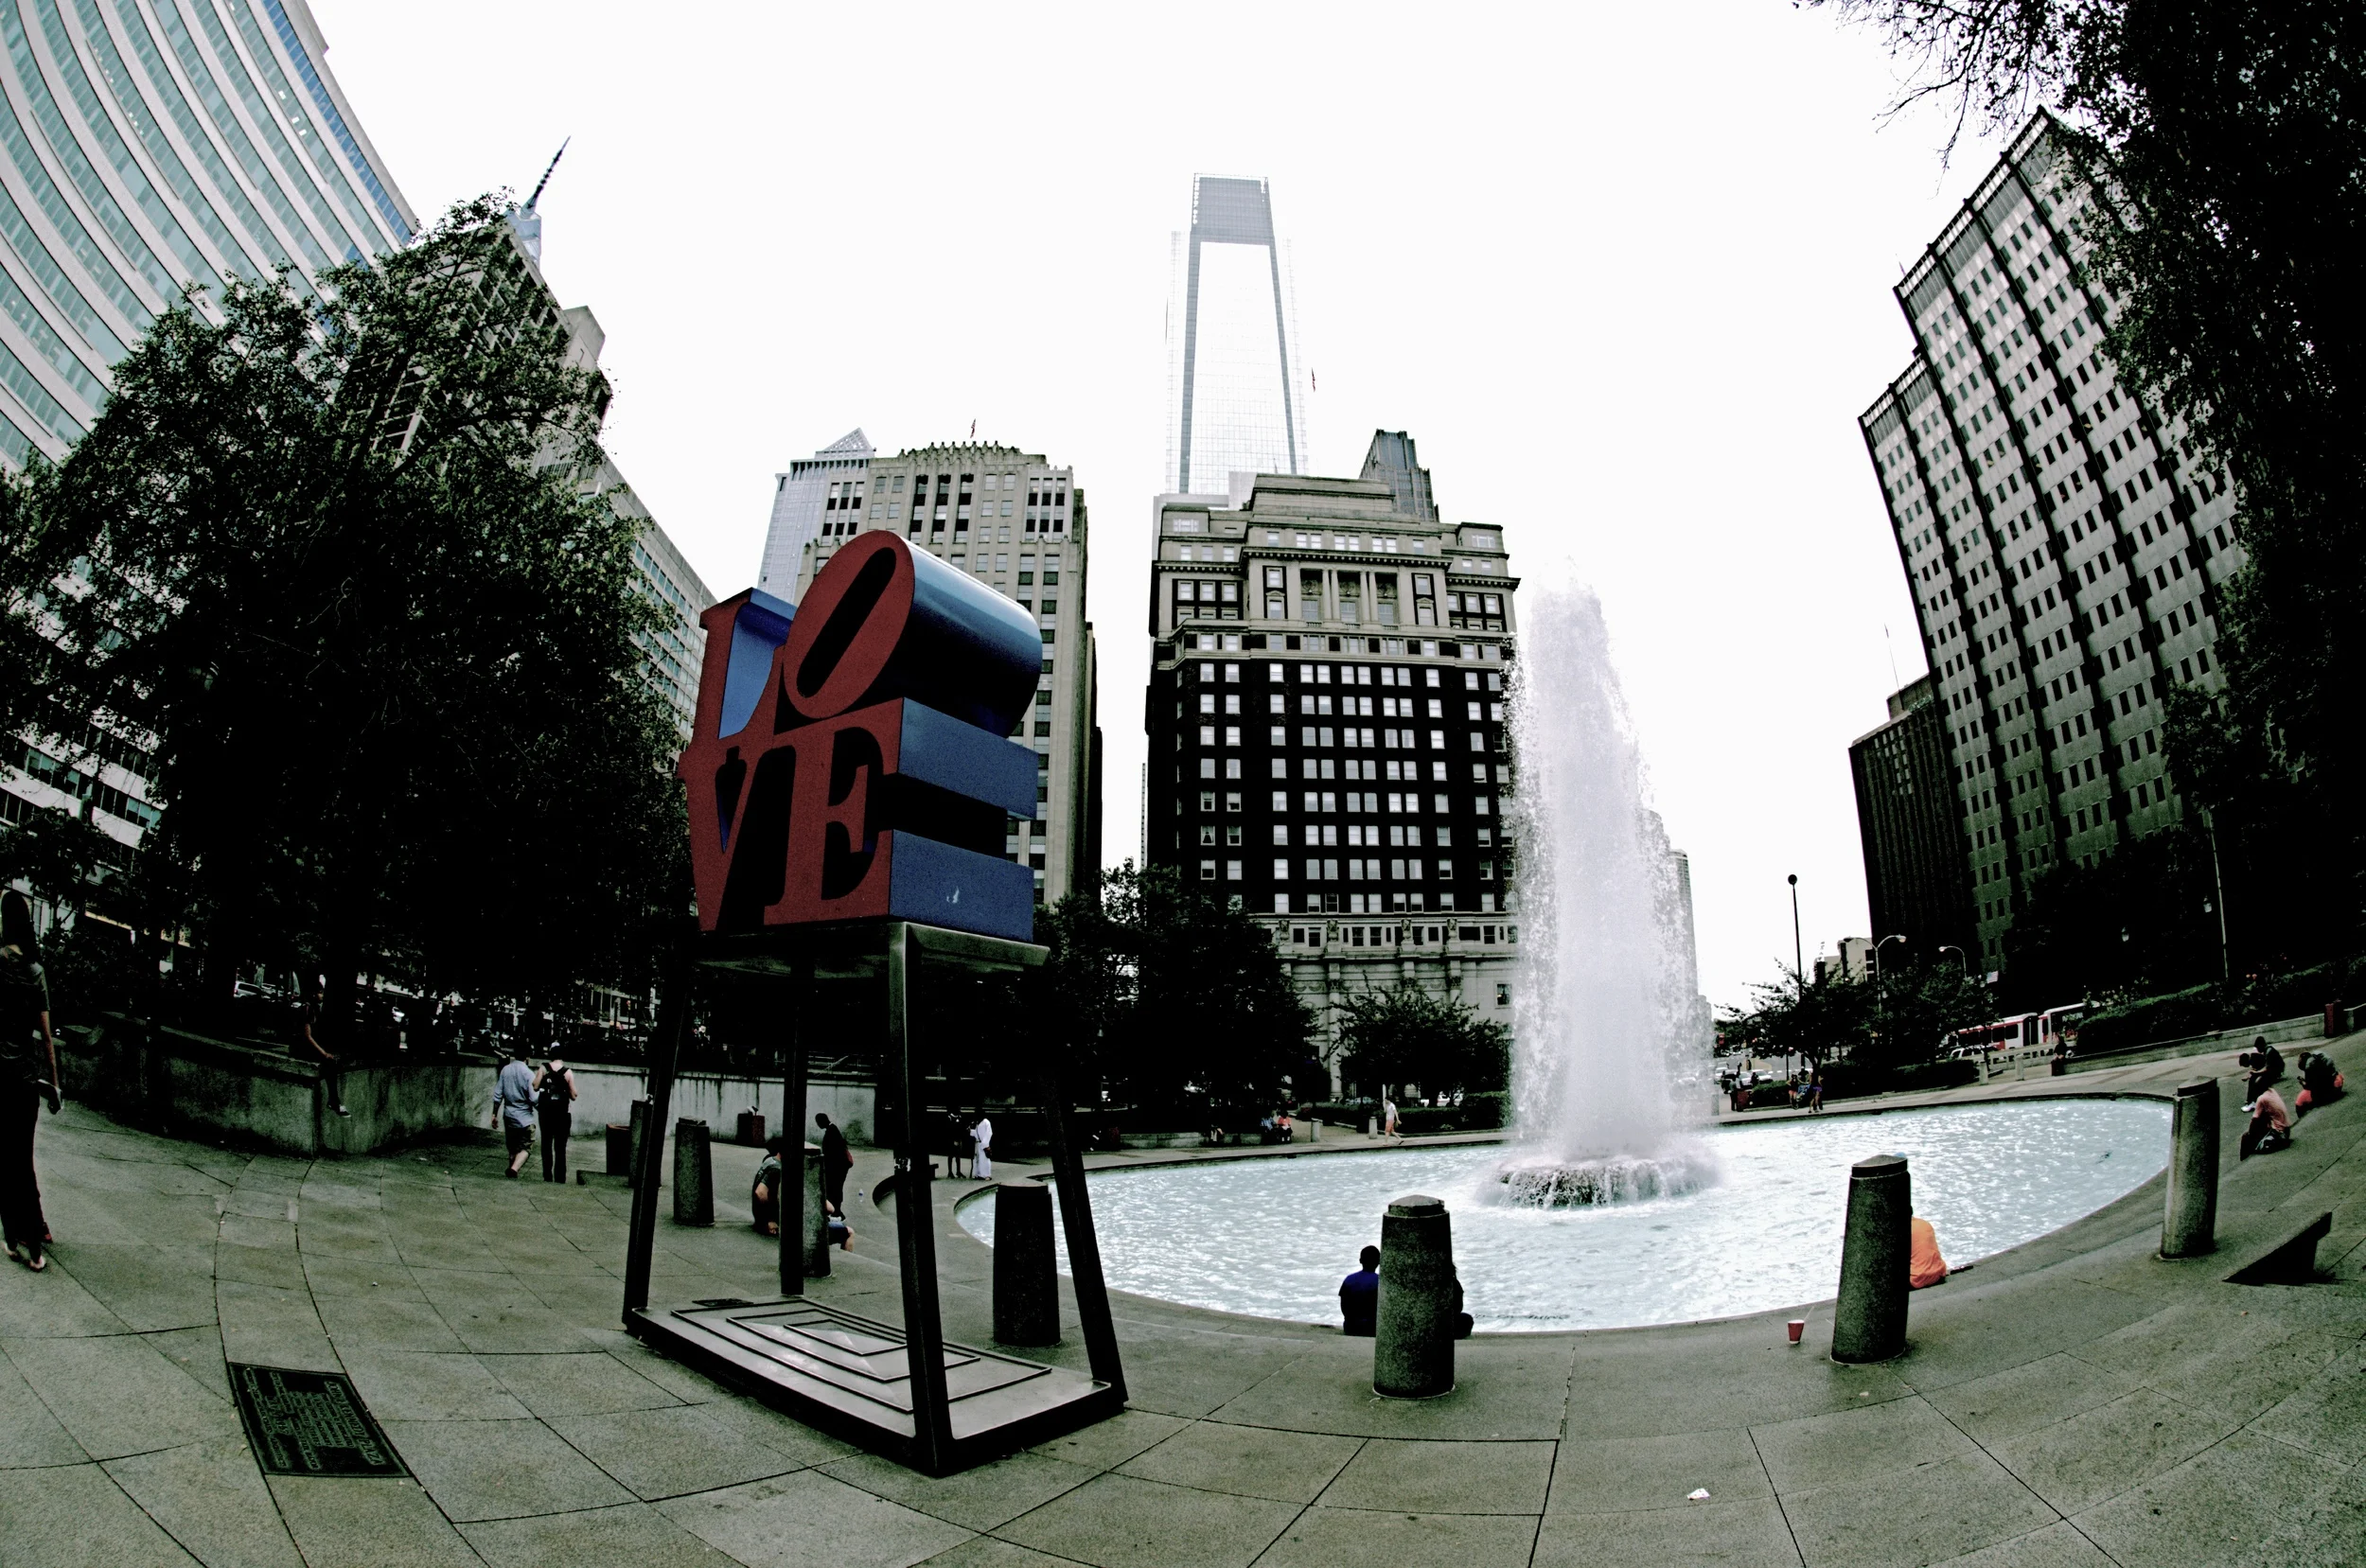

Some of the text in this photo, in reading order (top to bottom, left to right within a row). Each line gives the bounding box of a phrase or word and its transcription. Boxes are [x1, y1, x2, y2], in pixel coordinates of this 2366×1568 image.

[326, 1381, 344, 1399] JOHN
[336, 1403, 367, 1436] KENNEDY
[357, 1438, 384, 1464] PLAZA
